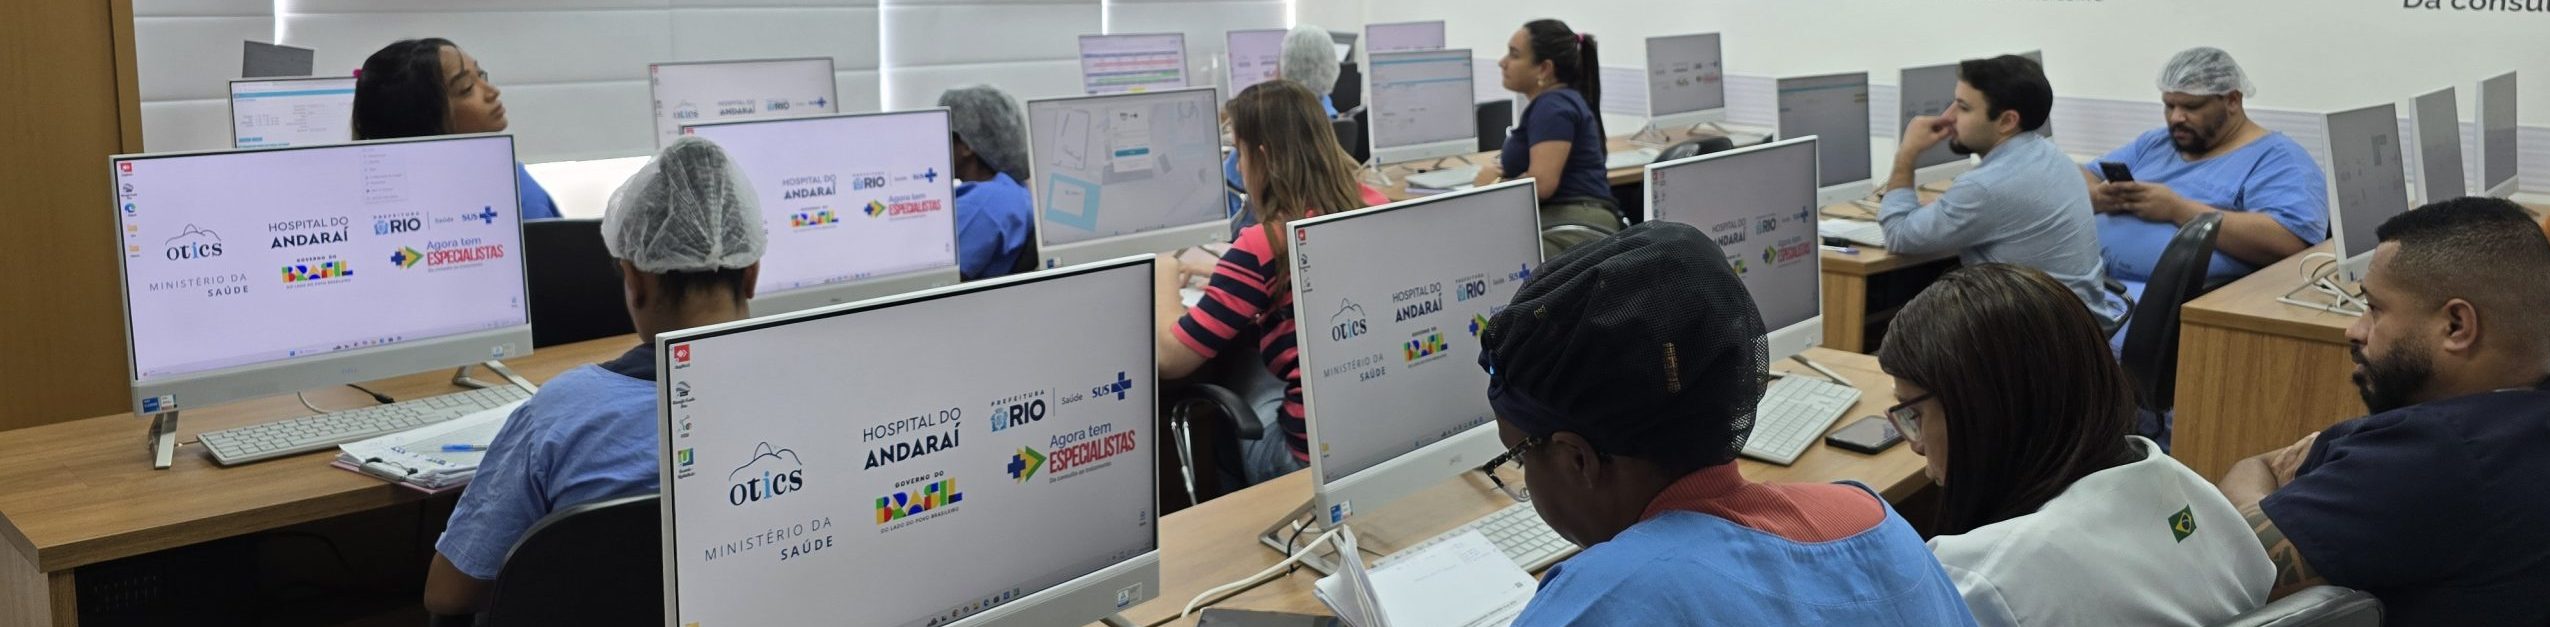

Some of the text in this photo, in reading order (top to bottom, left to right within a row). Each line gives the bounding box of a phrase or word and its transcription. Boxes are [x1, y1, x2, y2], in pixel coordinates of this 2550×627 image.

[2451, 0, 2550, 12] consu
[782, 174, 837, 186] HOSPITAL DO
[864, 176, 885, 188] RIO
[784, 181, 836, 200] ANDARAÍ
[889, 200, 942, 216] ESPECIALISTAS
[268, 216, 349, 232] HOSPITAL DO
[390, 218, 421, 233] RIO
[1763, 217, 1776, 233] RIO
[271, 226, 349, 249] ANDARAÍ
[427, 237, 482, 251] Agora tem
[166, 241, 223, 261] otics
[427, 245, 504, 266] ESPECIALISTAS
[149, 273, 247, 291] MINISTÉRIO DA
[281, 260, 353, 284] BRASIL
[207, 285, 249, 297] SAÚDE
[1392, 282, 1442, 304] HOSPITAL DO
[1466, 280, 1486, 300] RIO
[1395, 293, 1443, 323] ANDARAÍ
[1331, 318, 1367, 342] otics
[1323, 357, 1371, 378] MINISTÉRIO
[1360, 366, 1386, 382] SAÚDE
[990, 389, 1045, 407] PREFEITURA
[1061, 392, 1083, 405] Saúde
[1092, 384, 1110, 399] SUS
[1009, 398, 1046, 427] RIO
[863, 407, 961, 443] HOSPITAL DO
[1050, 422, 1112, 449] Agora tem
[864, 421, 961, 471] ANDARAÍ
[1049, 429, 1136, 474] ESPECIALISTAS
[729, 468, 803, 506] otics
[895, 470, 945, 489] GOVERNO DO
[875, 477, 963, 526] BRASIL
[704, 516, 832, 562] MINISTÉRIO DA
[780, 535, 833, 561] SAÚDE
